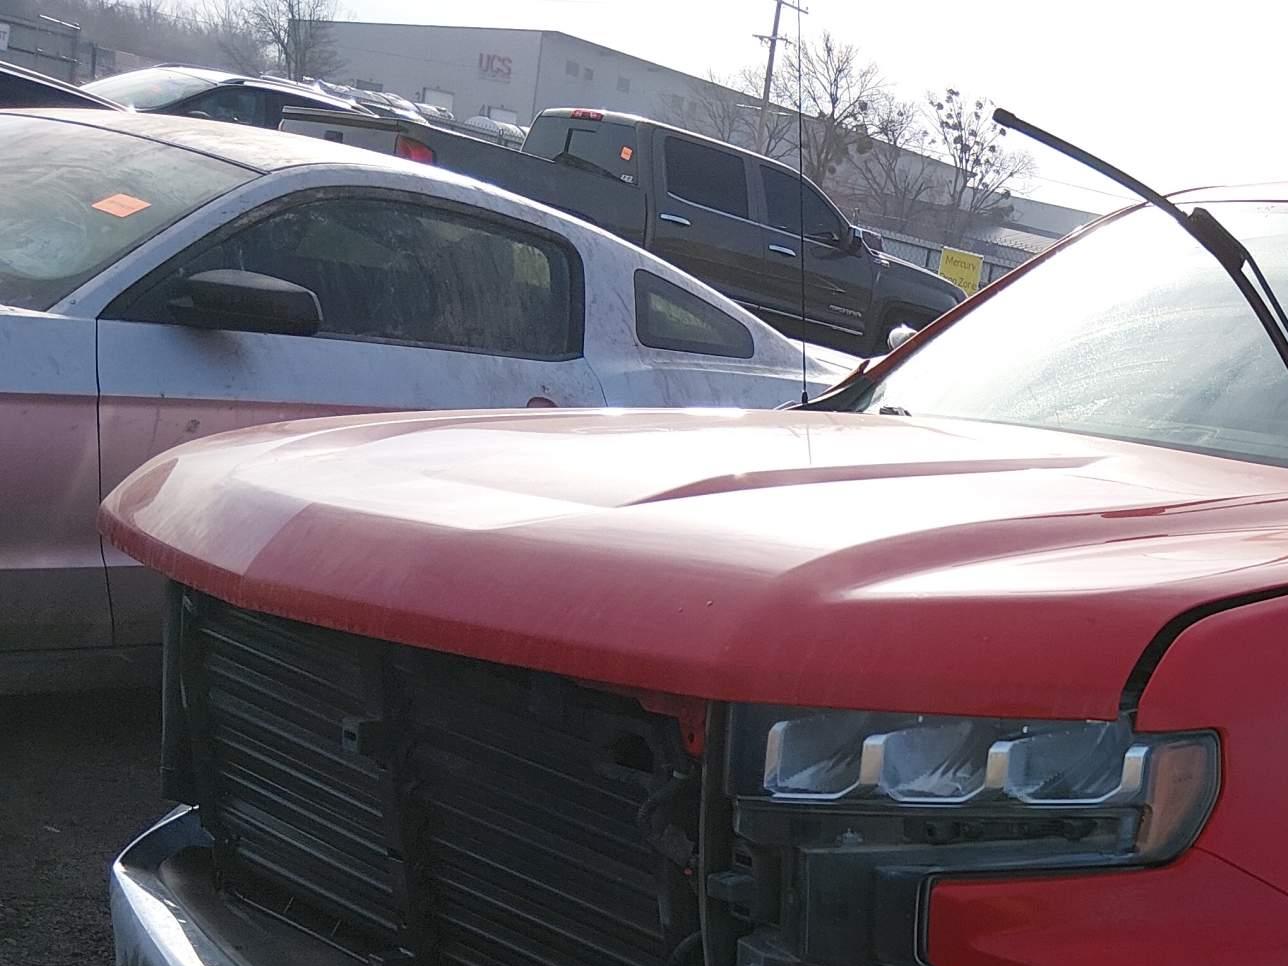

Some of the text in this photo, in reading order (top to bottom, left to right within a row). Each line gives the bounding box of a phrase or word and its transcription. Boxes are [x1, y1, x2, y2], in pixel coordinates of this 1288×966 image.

[479, 52, 512, 76] UCS
[945, 255, 976, 271] Mercury
[958, 277, 977, 290] Zone
